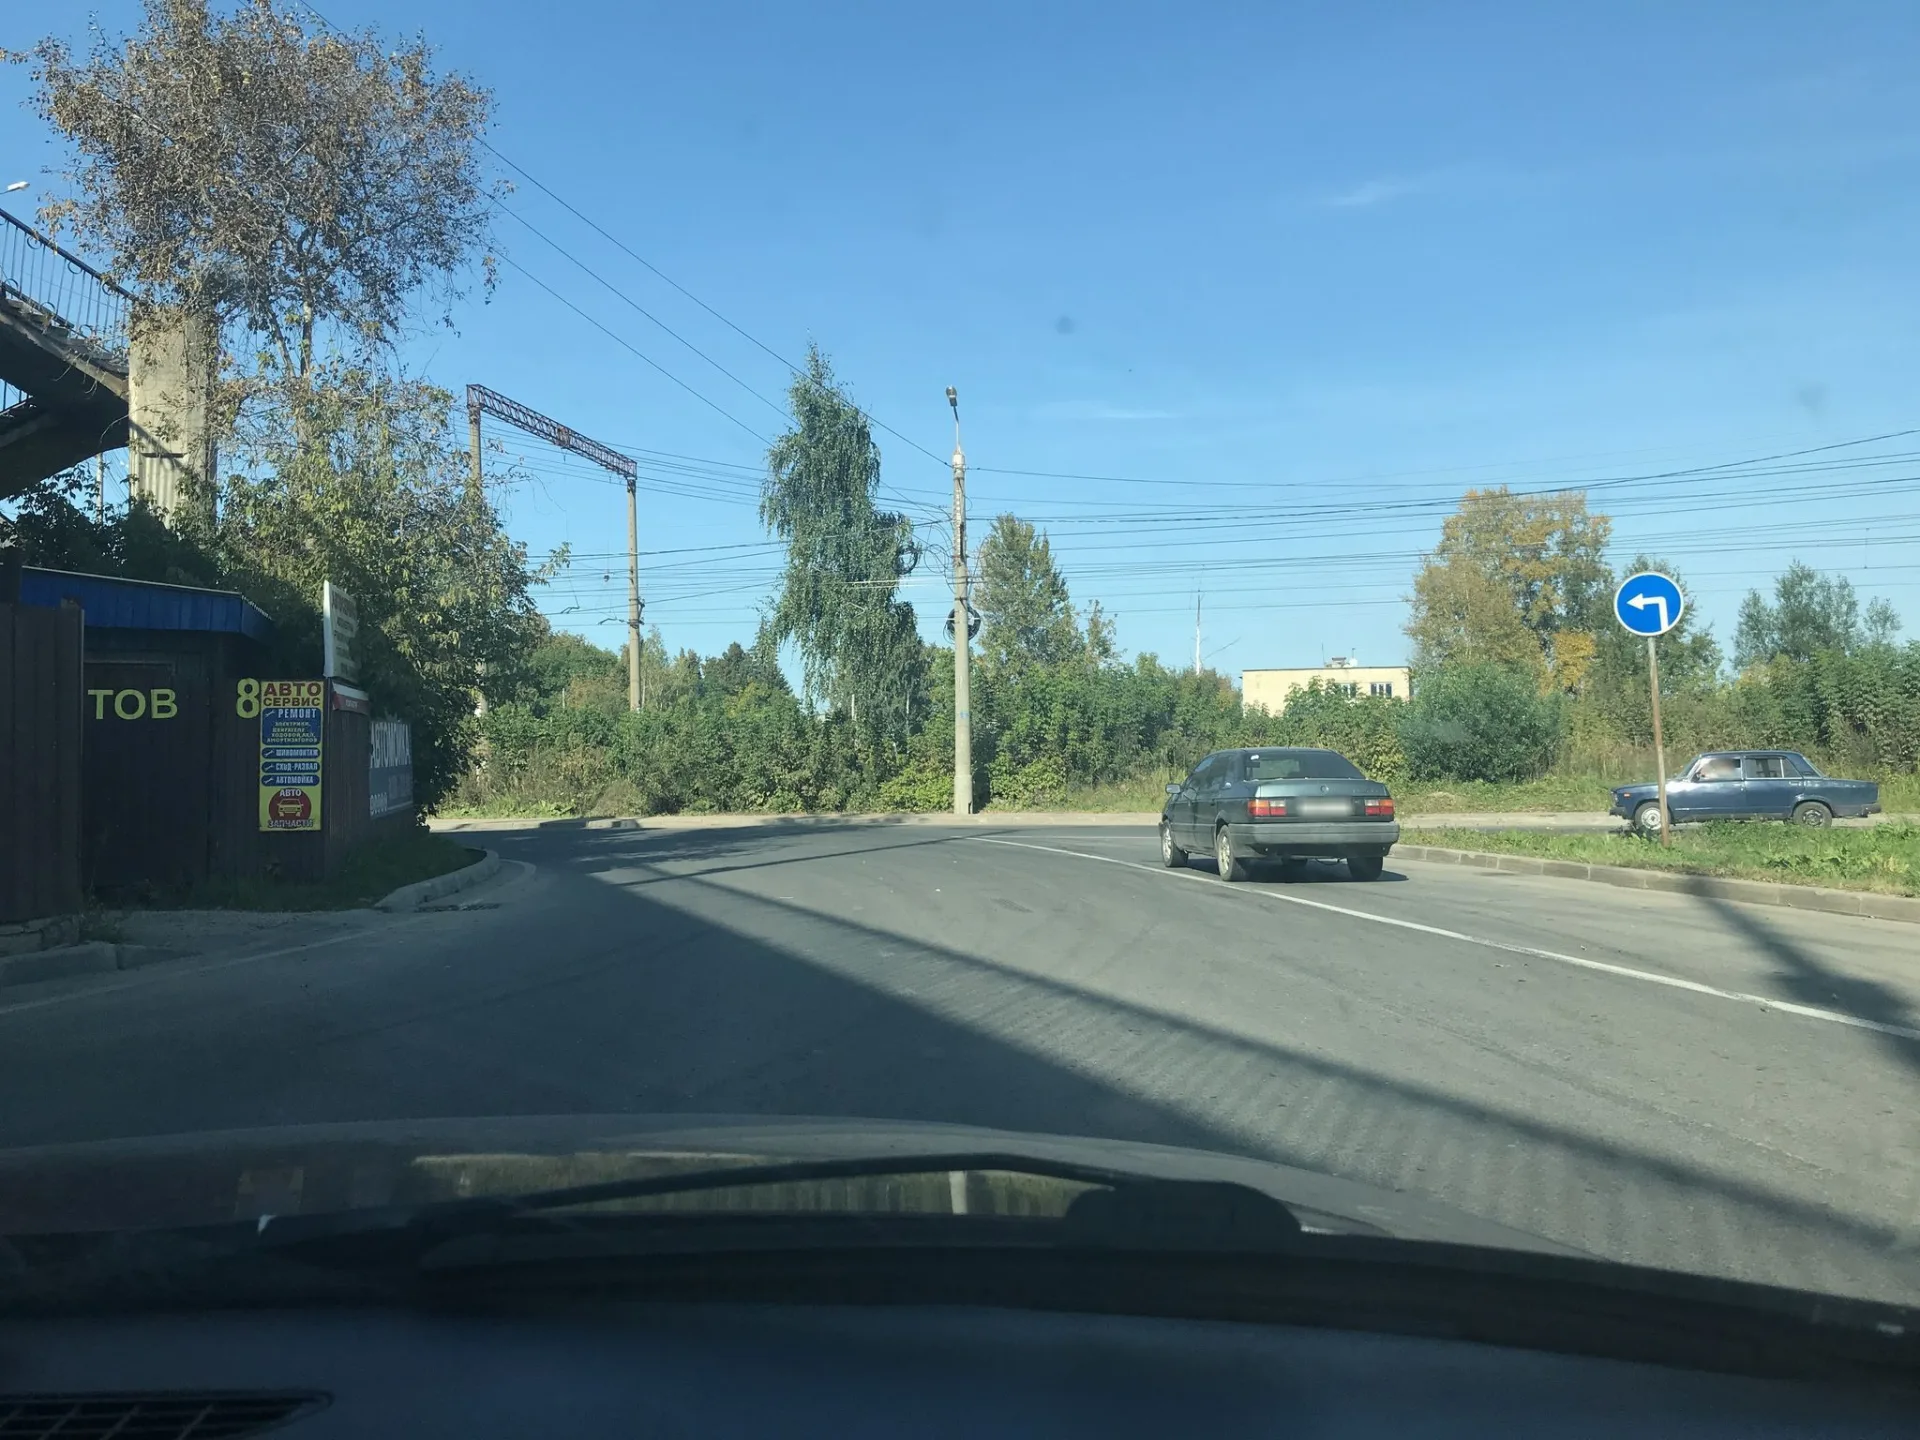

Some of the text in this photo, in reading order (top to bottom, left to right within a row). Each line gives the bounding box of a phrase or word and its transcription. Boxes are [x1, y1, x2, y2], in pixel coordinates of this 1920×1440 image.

[264, 682, 322, 697] АВТО
[236, 678, 259, 718] 8
[263, 697, 321, 707] СЕРВИС
[88, 689, 178, 720] ТОВ
[278, 708, 317, 719] РЕМОНТ
[275, 748, 318, 757] ШИНОМОНТАЖ
[275, 763, 318, 771] СХОД-РАЗВАЛ
[275, 775, 314, 784] АВТОМОЙКА
[279, 788, 302, 797] АВТО
[267, 819, 313, 829] ЗАПЧАСТИ
